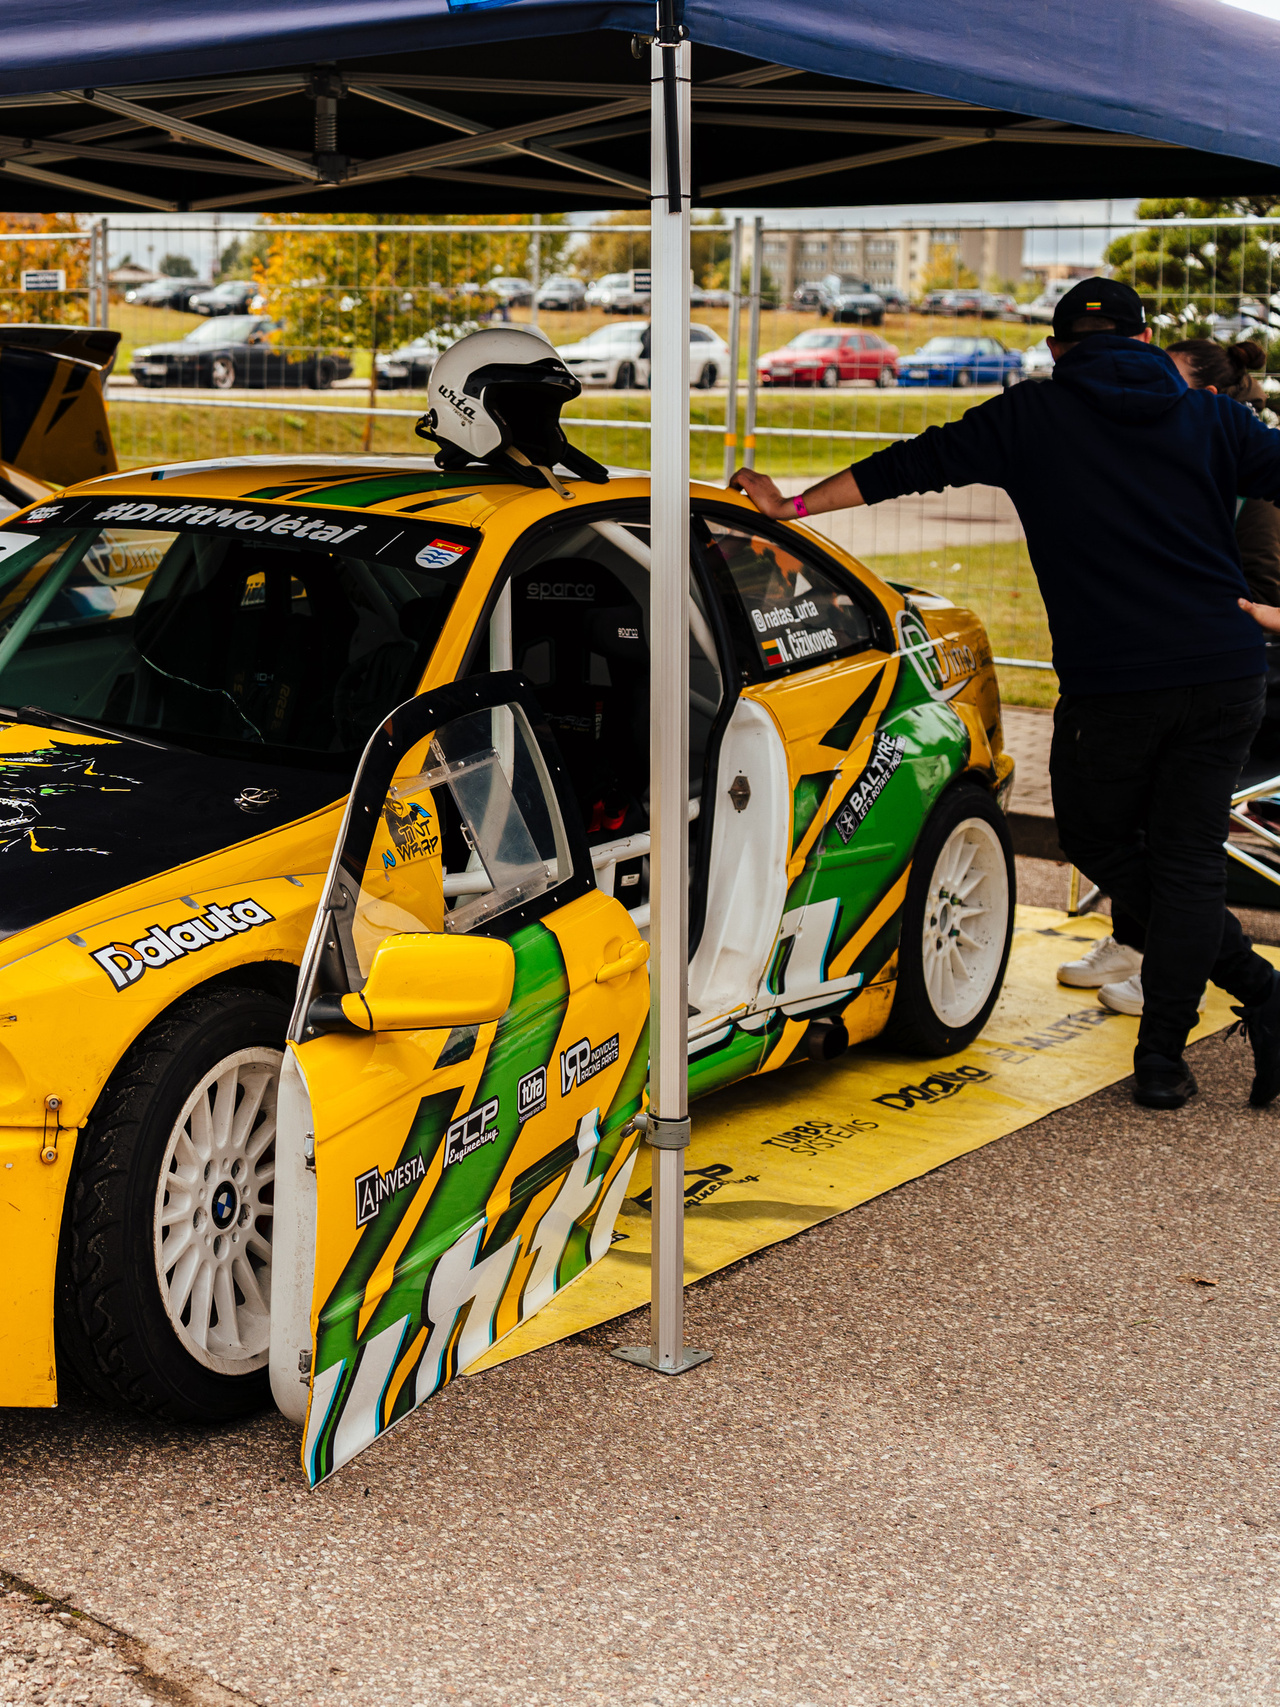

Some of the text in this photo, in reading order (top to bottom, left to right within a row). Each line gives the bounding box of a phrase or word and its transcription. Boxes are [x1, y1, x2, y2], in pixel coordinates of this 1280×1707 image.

[437, 385, 477, 420] urta
[93, 502, 368, 544] #DriftMolėtai
[526, 582, 596, 600] sparco
[751, 599, 819, 633] @natas_urta
[871, 769, 891, 798] ROTATE
[396, 835, 439, 862] WRAP
[398, 819, 431, 844] TINT
[91, 898, 274, 989] Dalauta
[581, 1047, 619, 1081] RACING PARTS
[591, 1037, 618, 1062] INDIVIDUAL
[448, 1127, 499, 1165] Engineering
[761, 1120, 834, 1149] TURBO
[789, 1119, 879, 1156] SYSTEMS
